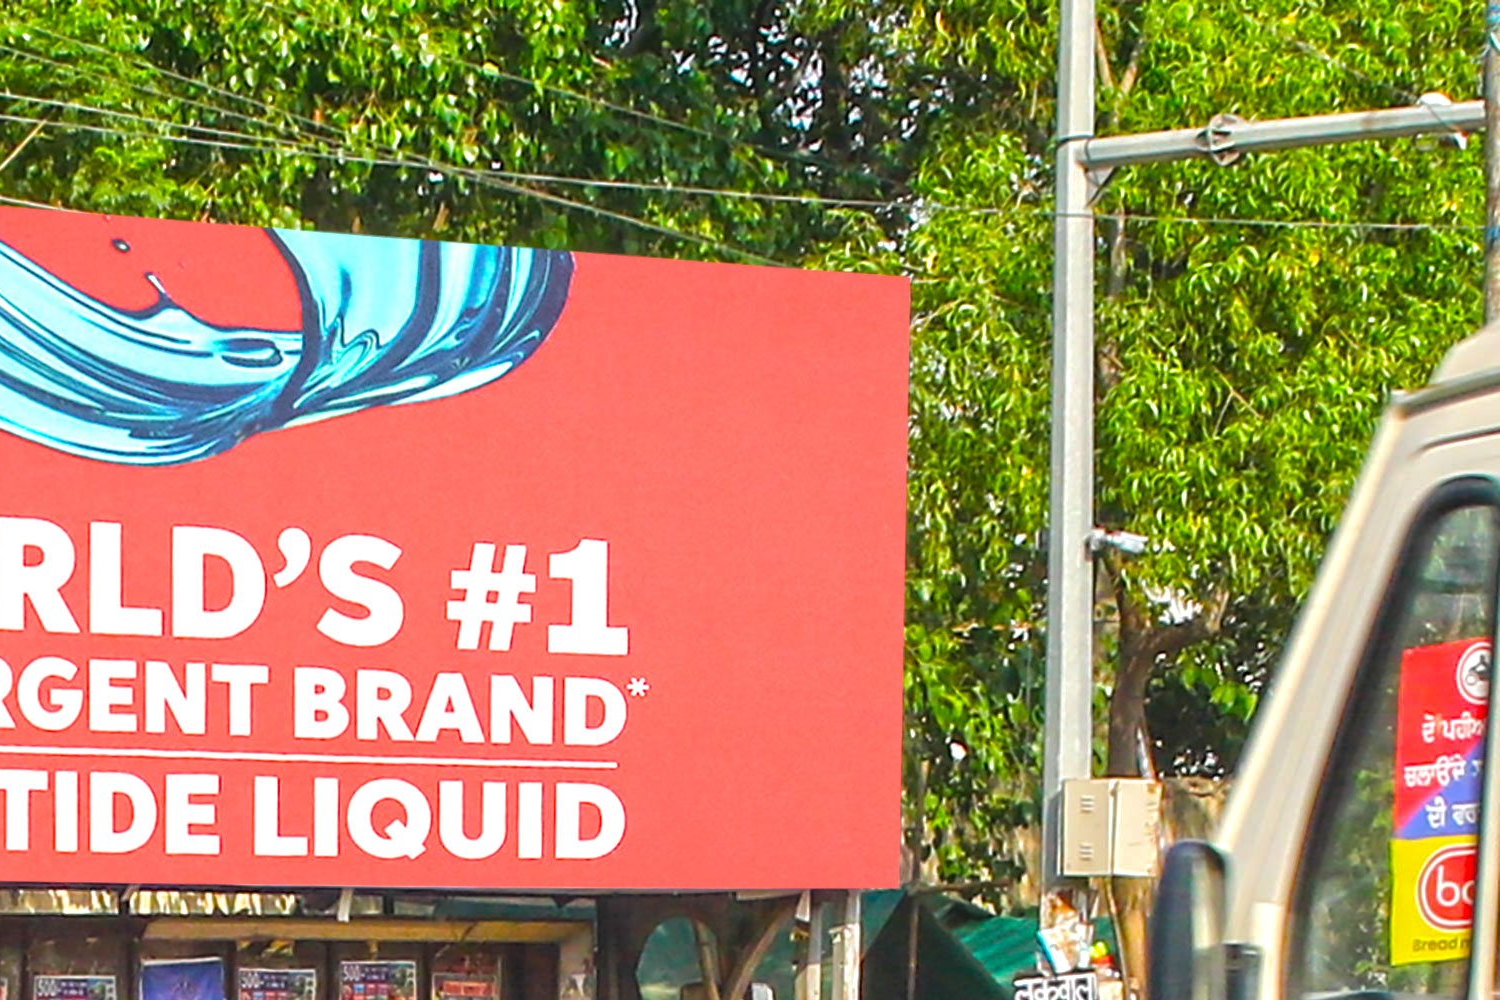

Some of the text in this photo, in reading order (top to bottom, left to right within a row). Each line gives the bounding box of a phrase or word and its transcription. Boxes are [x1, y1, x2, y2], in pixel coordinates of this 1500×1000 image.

[446, 538, 629, 656] #1
[253, 775, 627, 861] LIQUID
[1412, 938, 1458, 952] Bread
